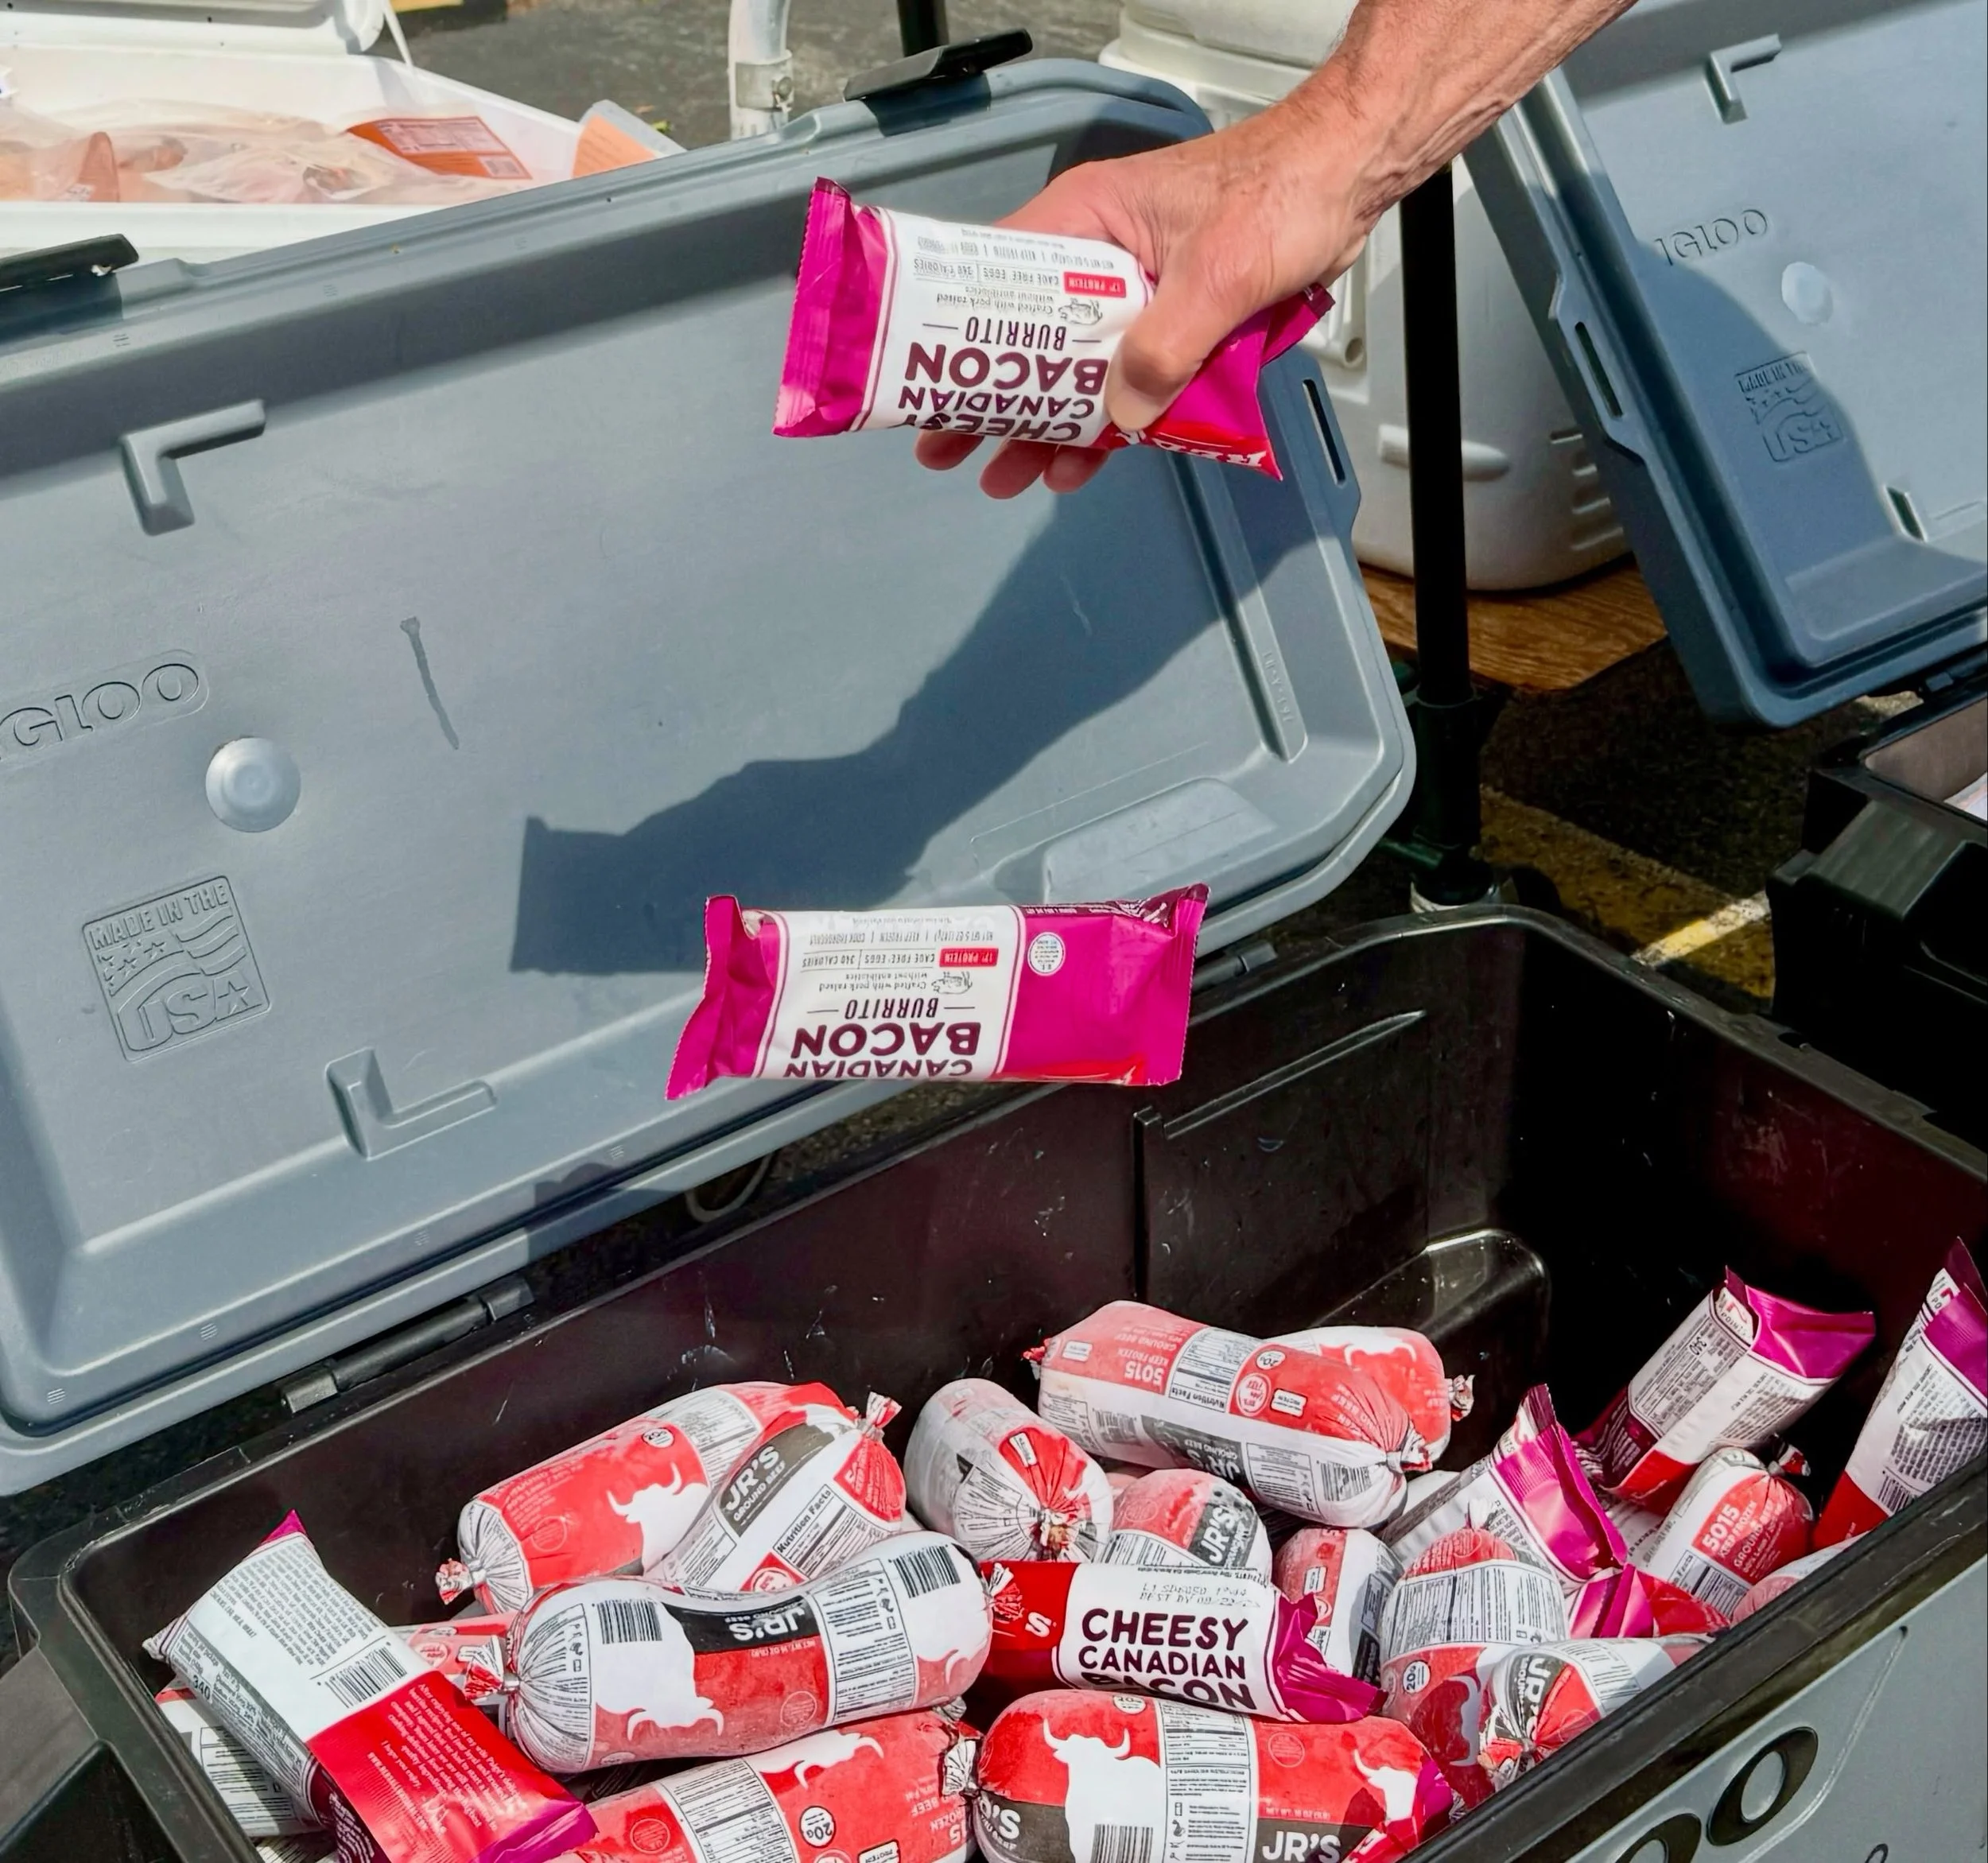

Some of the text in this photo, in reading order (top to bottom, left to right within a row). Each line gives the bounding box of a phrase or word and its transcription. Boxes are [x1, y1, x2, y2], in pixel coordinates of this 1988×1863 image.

[1654, 209, 1769, 265] IGLOO
[983, 267, 1059, 286] CAGE FREE EGGS
[1068, 278, 1105, 291] PROTEIN
[969, 296, 991, 308] pork
[994, 300, 1015, 311] with
[1017, 302, 1053, 315] Crafted
[965, 316, 1066, 351] BURRITO
[905, 342, 1109, 395] BACON
[898, 386, 1094, 419] CANADIAN
[902, 413, 1081, 441] CHEESY
[89, 883, 229, 950] MADE IN THE
[802, 956, 839, 968] CALORIES
[864, 954, 886, 965] EGGS
[914, 953, 935, 963] CAGE
[945, 953, 978, 964] PROTEIN
[818, 980, 926, 992] Crafted with pork raised
[118, 970, 263, 1052] USA
[845, 998, 938, 1019] BURRITO
[790, 1022, 981, 1059] BACON
[782, 1059, 973, 1078] CANADIAN
[1686, 1335, 1708, 1357] 340
[1122, 1360, 1165, 1385] 5015
[1170, 1386, 1225, 1409] Nutrition Facts
[719, 1442, 781, 1512] JR'S
[732, 1459, 787, 1522] GROUND BEEF
[775, 1488, 832, 1554] Nutrition Facts
[1196, 1504, 1239, 1564] JR'S
[1700, 1502, 1741, 1552] 5015
[1718, 1499, 1760, 1557] KEEP FROZEN
[1730, 1523, 1766, 1567] GROUND
[728, 1606, 804, 1640] JR'S
[1082, 1609, 1248, 1651] CHEESY
[1078, 1645, 1245, 1679] CANADIAN
[188, 1673, 215, 1702] 340
[418, 1682, 433, 1698] After
[911, 1797, 939, 1817] BEEF
[930, 1807, 964, 1831] ROZEN
[980, 1791, 1021, 1839] R'S
[806, 1822, 833, 1841] 20G
[1262, 1830, 1342, 1863] JR'S
